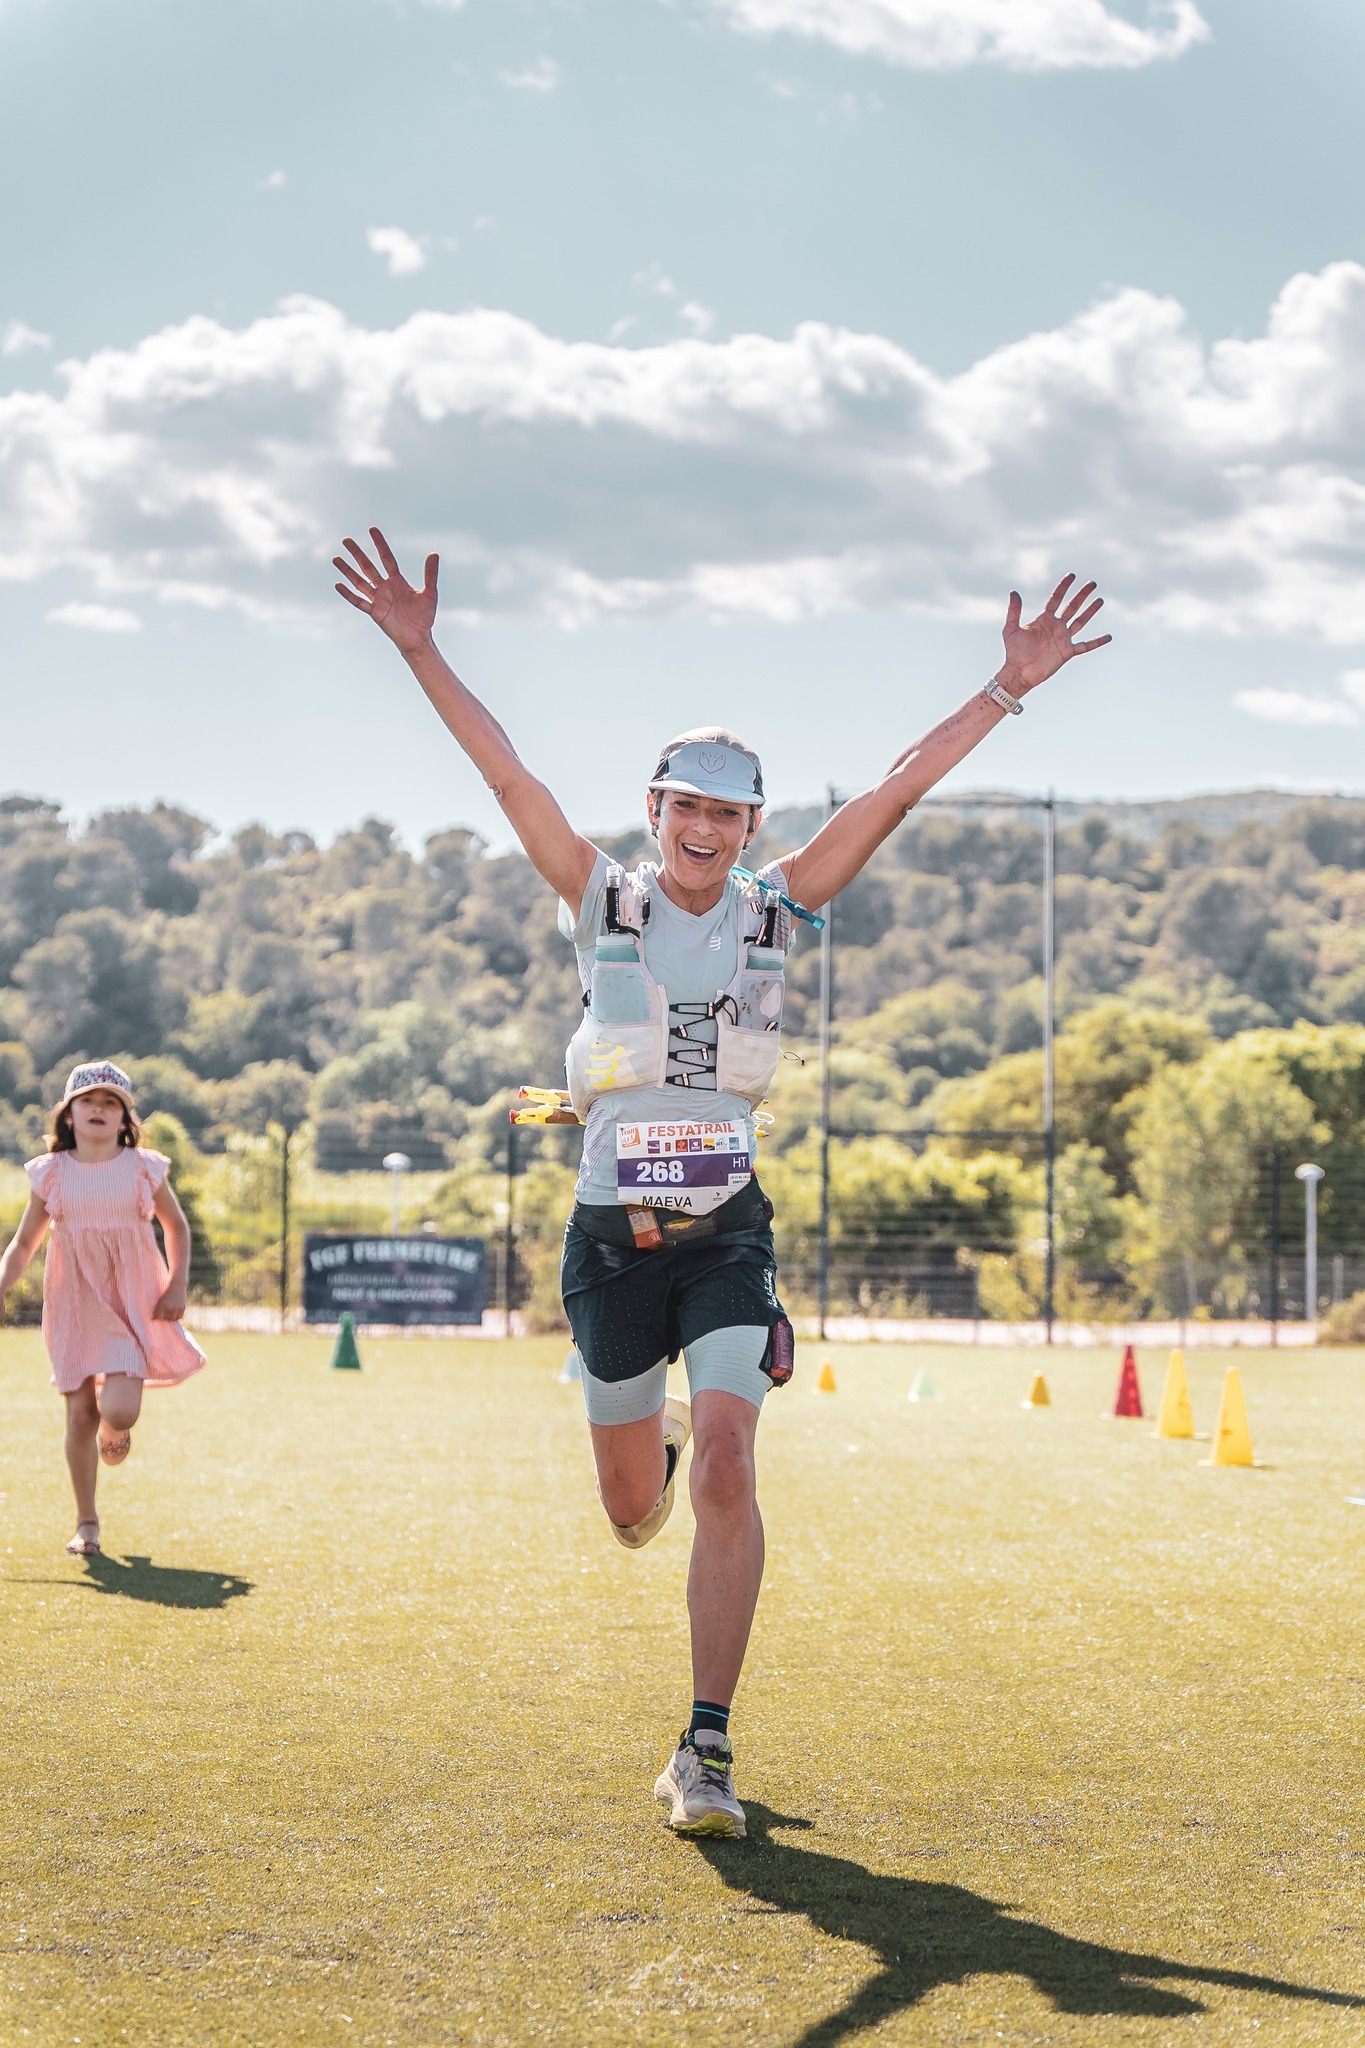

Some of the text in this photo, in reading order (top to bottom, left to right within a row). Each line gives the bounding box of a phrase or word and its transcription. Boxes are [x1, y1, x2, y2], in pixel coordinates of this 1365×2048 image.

[647, 1122, 735, 1138] FESTATRAIL
[732, 1156, 747, 1168] HT
[636, 1160, 685, 1183] 268
[641, 1195, 693, 1207] MAEVA
